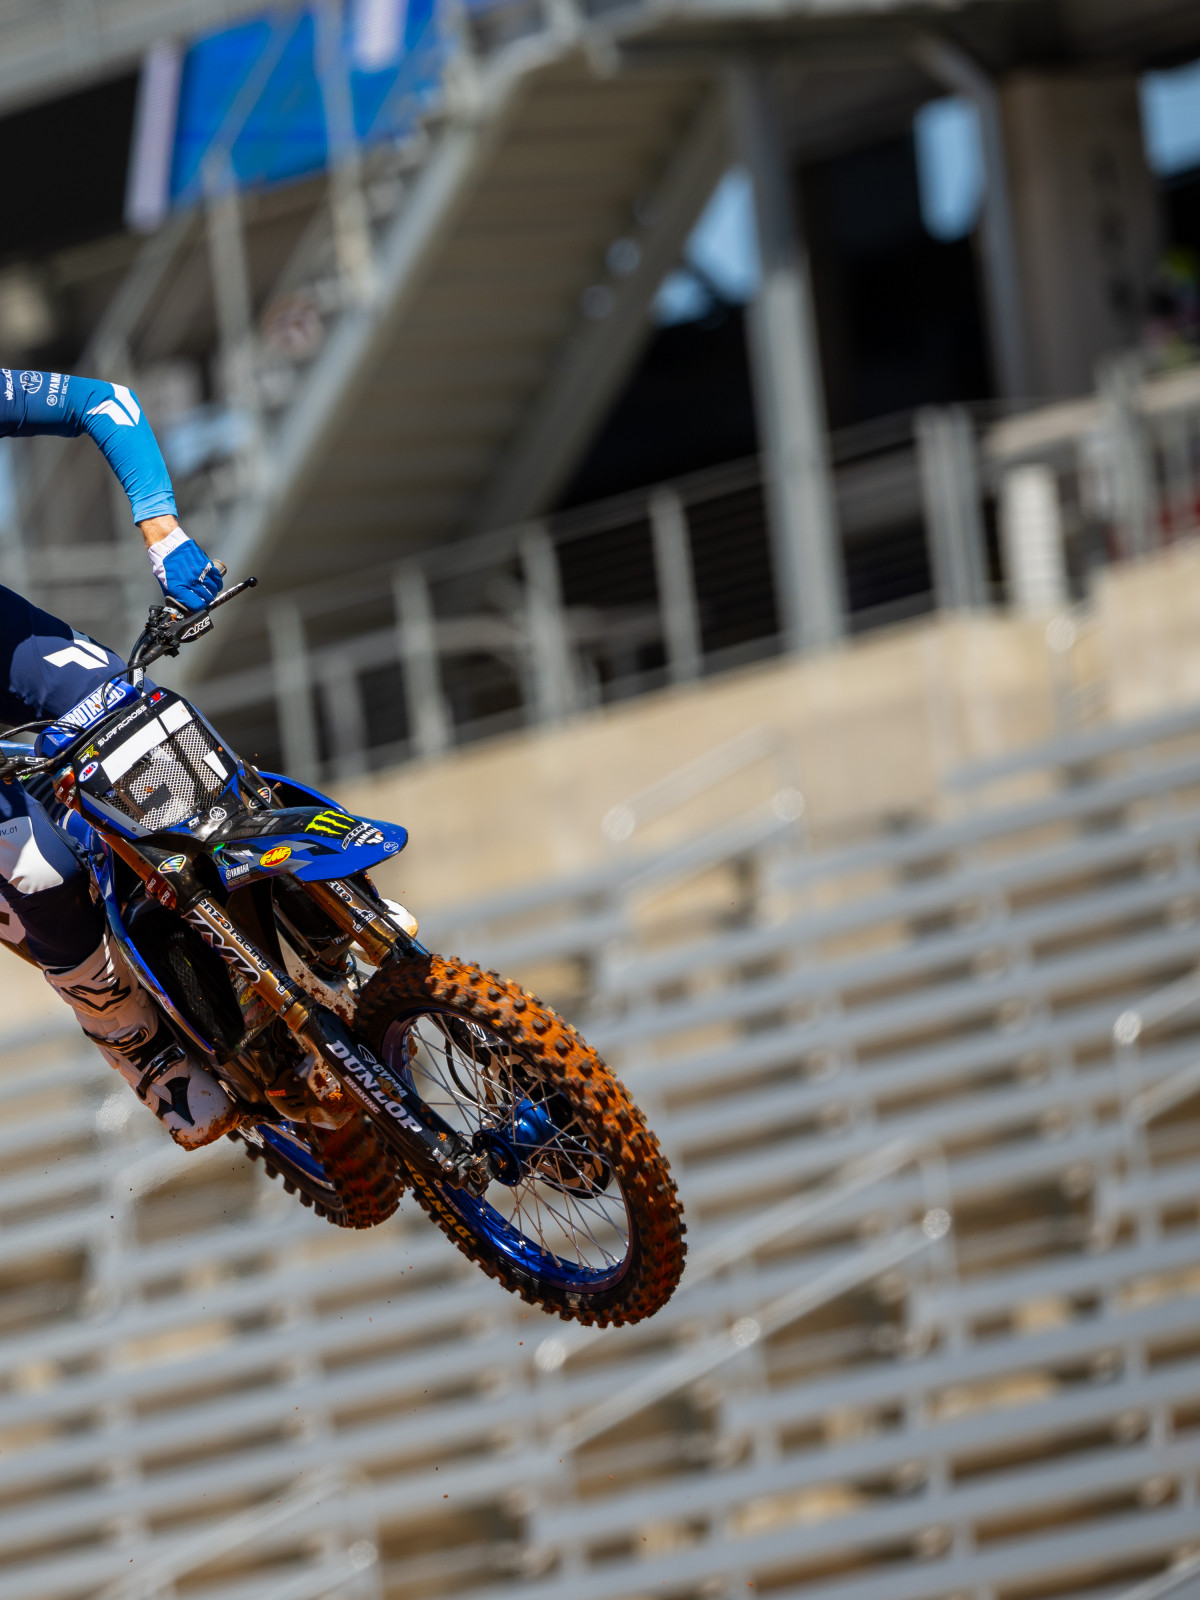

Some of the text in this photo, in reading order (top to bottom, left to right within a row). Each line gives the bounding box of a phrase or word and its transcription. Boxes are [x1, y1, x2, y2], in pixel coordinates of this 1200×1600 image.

[97, 705, 147, 746] SUPERCROSS
[326, 1039, 423, 1133] DUNLOP
[344, 1075, 381, 1114] BRAKING
